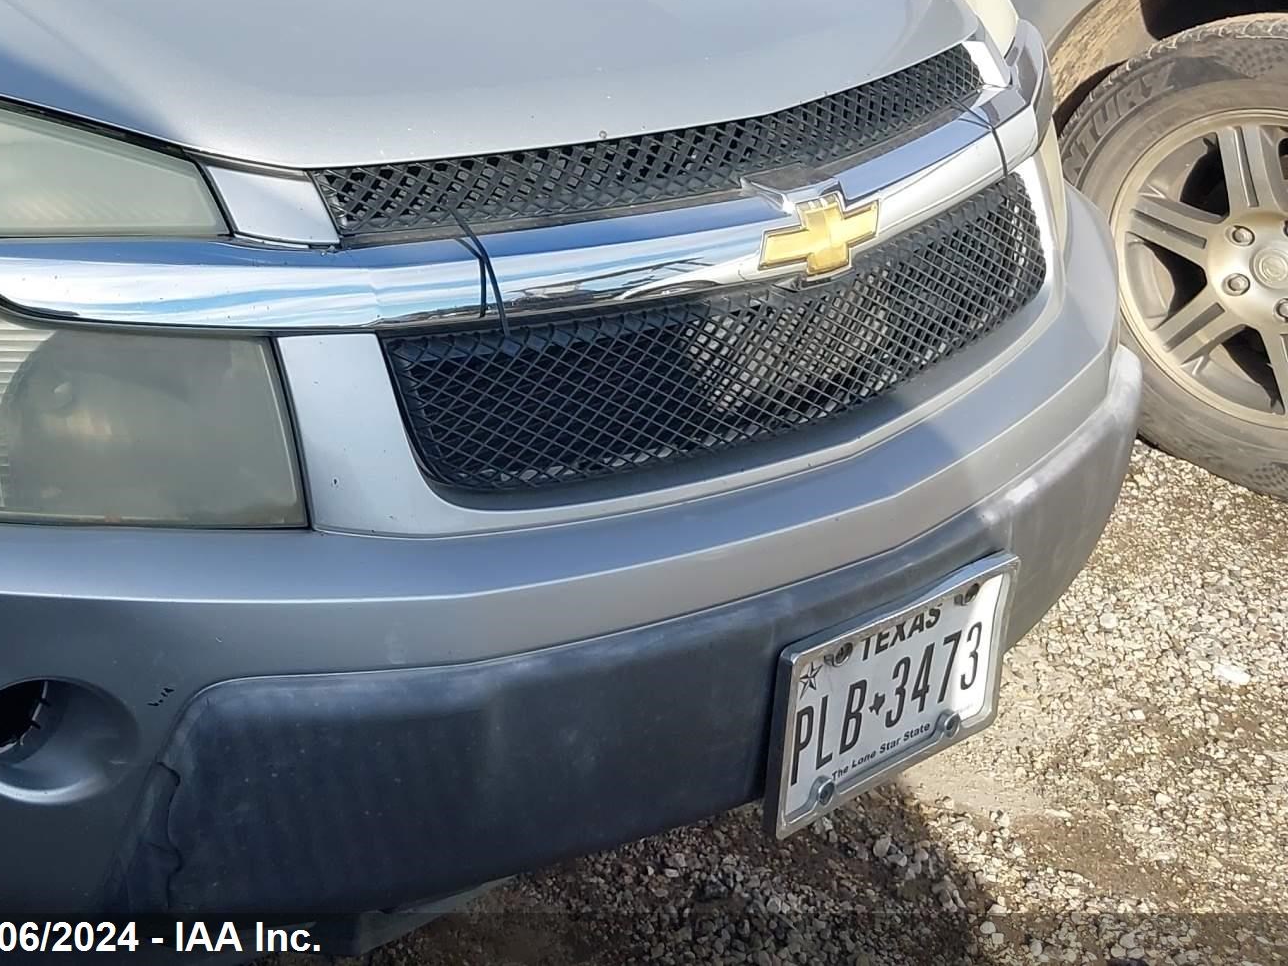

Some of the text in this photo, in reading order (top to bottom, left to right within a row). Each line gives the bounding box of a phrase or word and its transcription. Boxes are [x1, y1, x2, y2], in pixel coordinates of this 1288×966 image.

[861, 603, 943, 662] TEXAS
[832, 723, 931, 781] The Lone Star State
